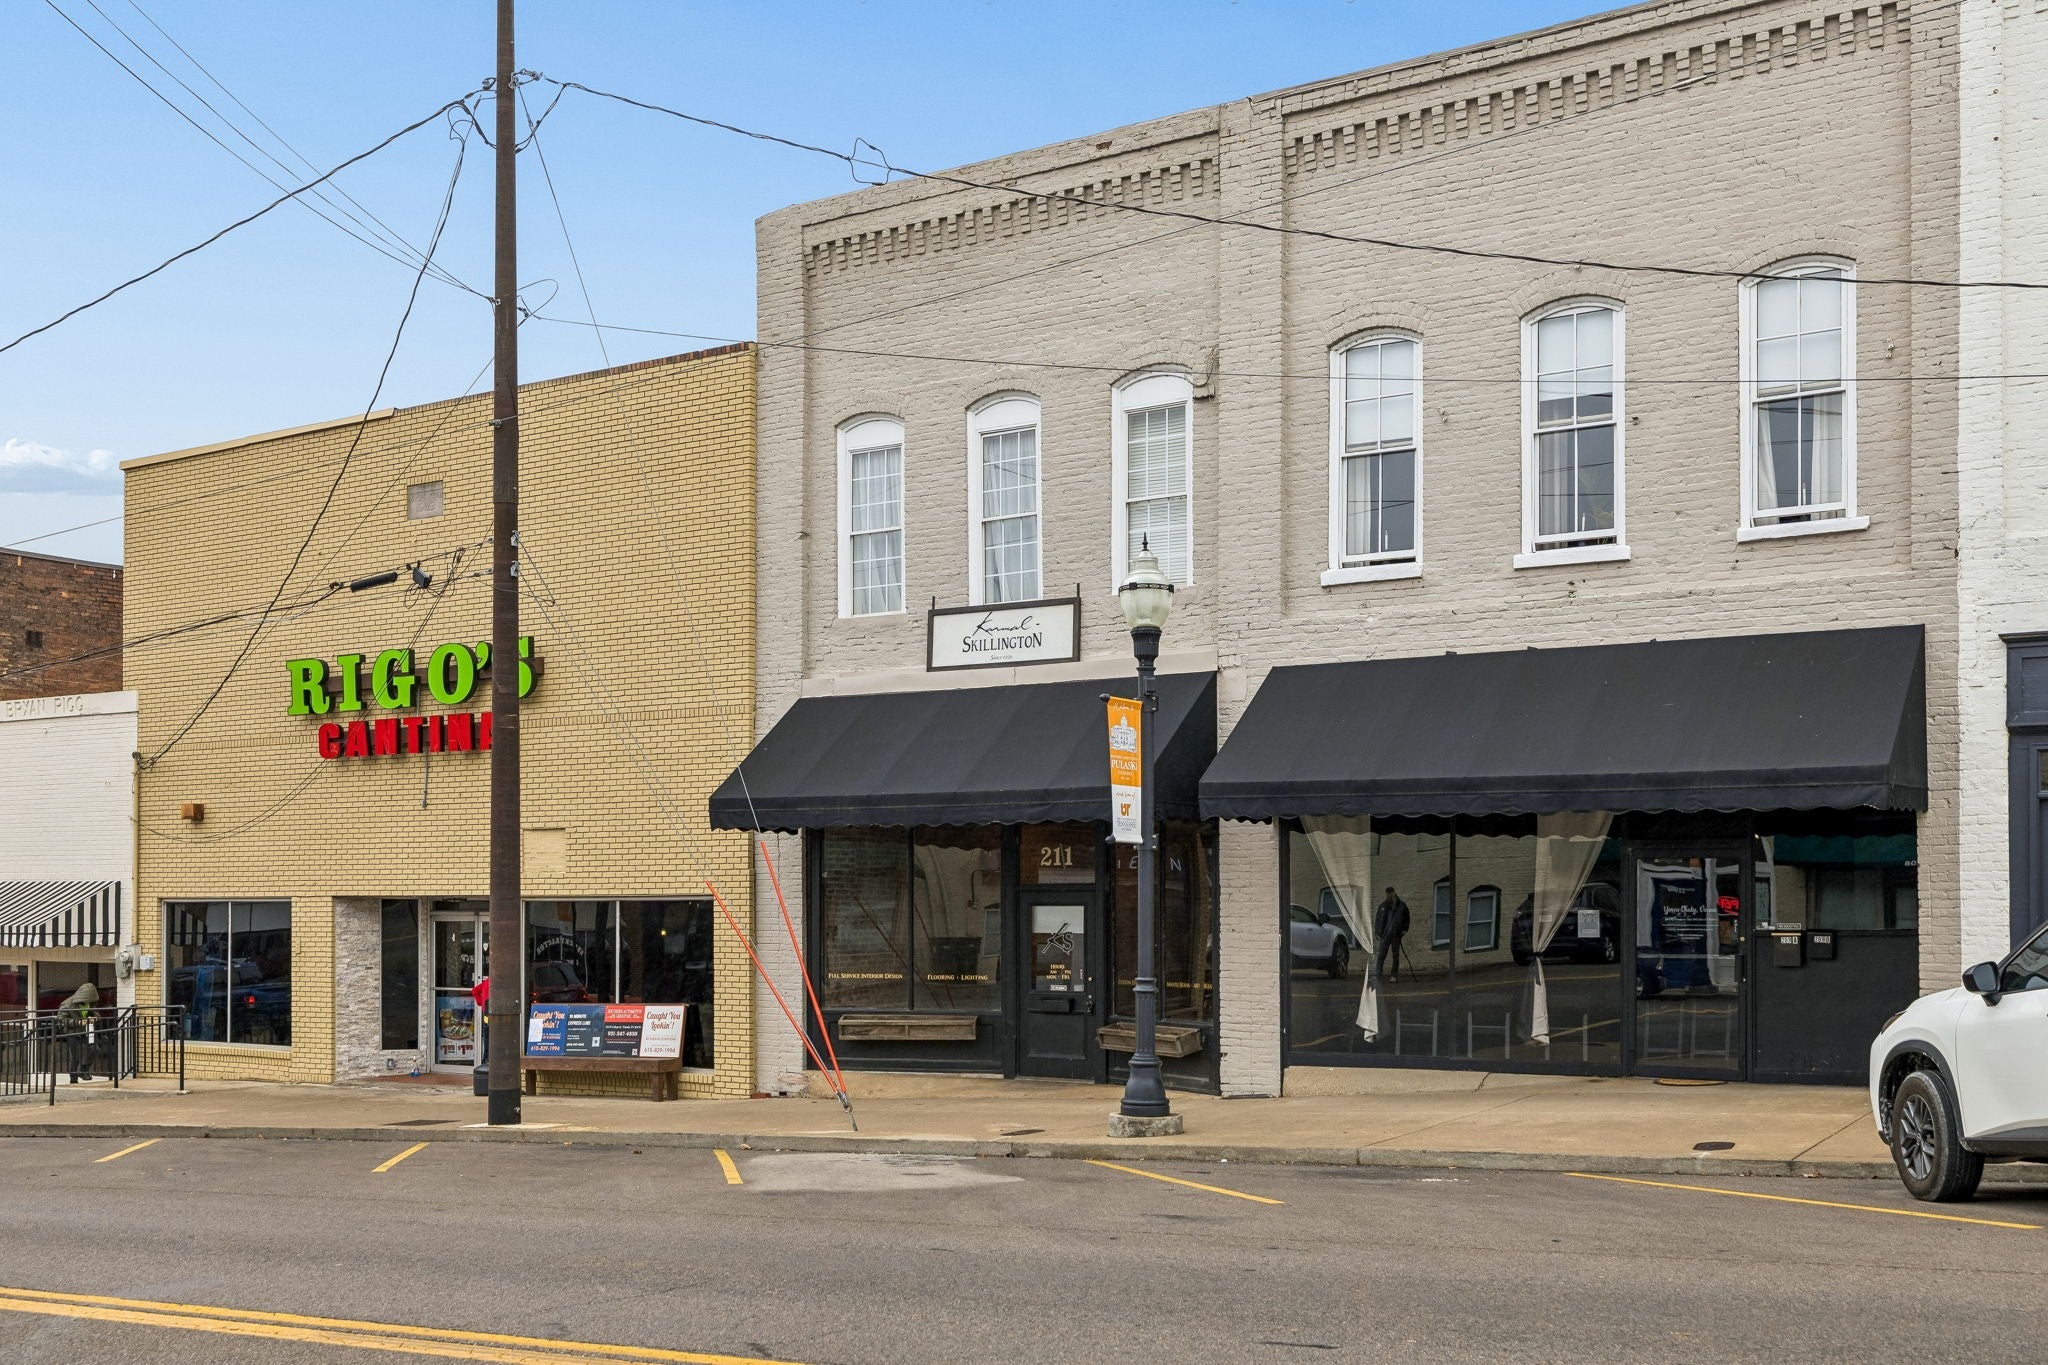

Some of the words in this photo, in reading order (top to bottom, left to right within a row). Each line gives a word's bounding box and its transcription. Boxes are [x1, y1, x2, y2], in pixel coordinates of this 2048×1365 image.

[962, 632, 1042, 653] SKILLINGTON
[1041, 847, 1072, 866] 211
[646, 1011, 669, 1022] Caught
[669, 1011, 680, 1020] You
